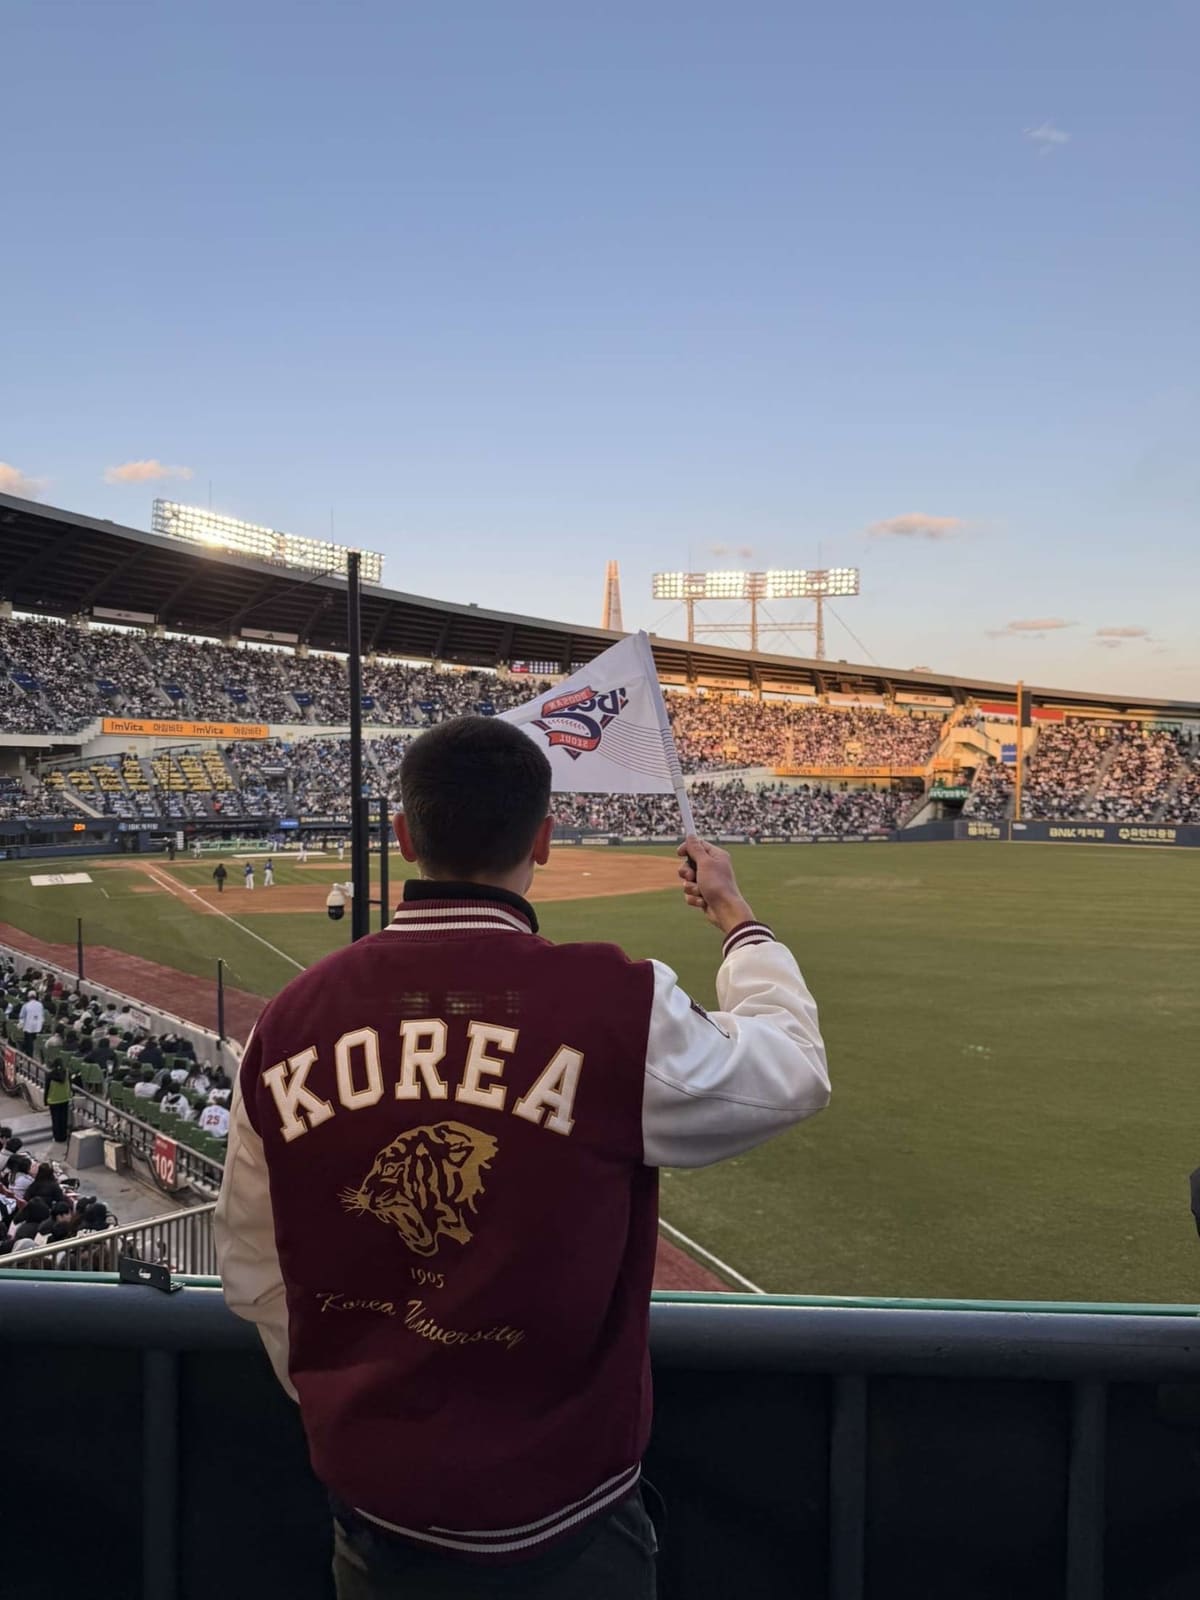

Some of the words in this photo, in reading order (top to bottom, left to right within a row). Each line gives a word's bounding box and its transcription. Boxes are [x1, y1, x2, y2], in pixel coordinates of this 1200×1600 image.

[111, 721, 144, 731] ImVita
[262, 1017, 585, 1144] KOREA
[206, 1114, 220, 1125] 25
[155, 1153, 174, 1185] 102
[410, 1267, 445, 1289] 1905
[315, 1292, 397, 1316] Korea
[404, 1299, 526, 1350] University
